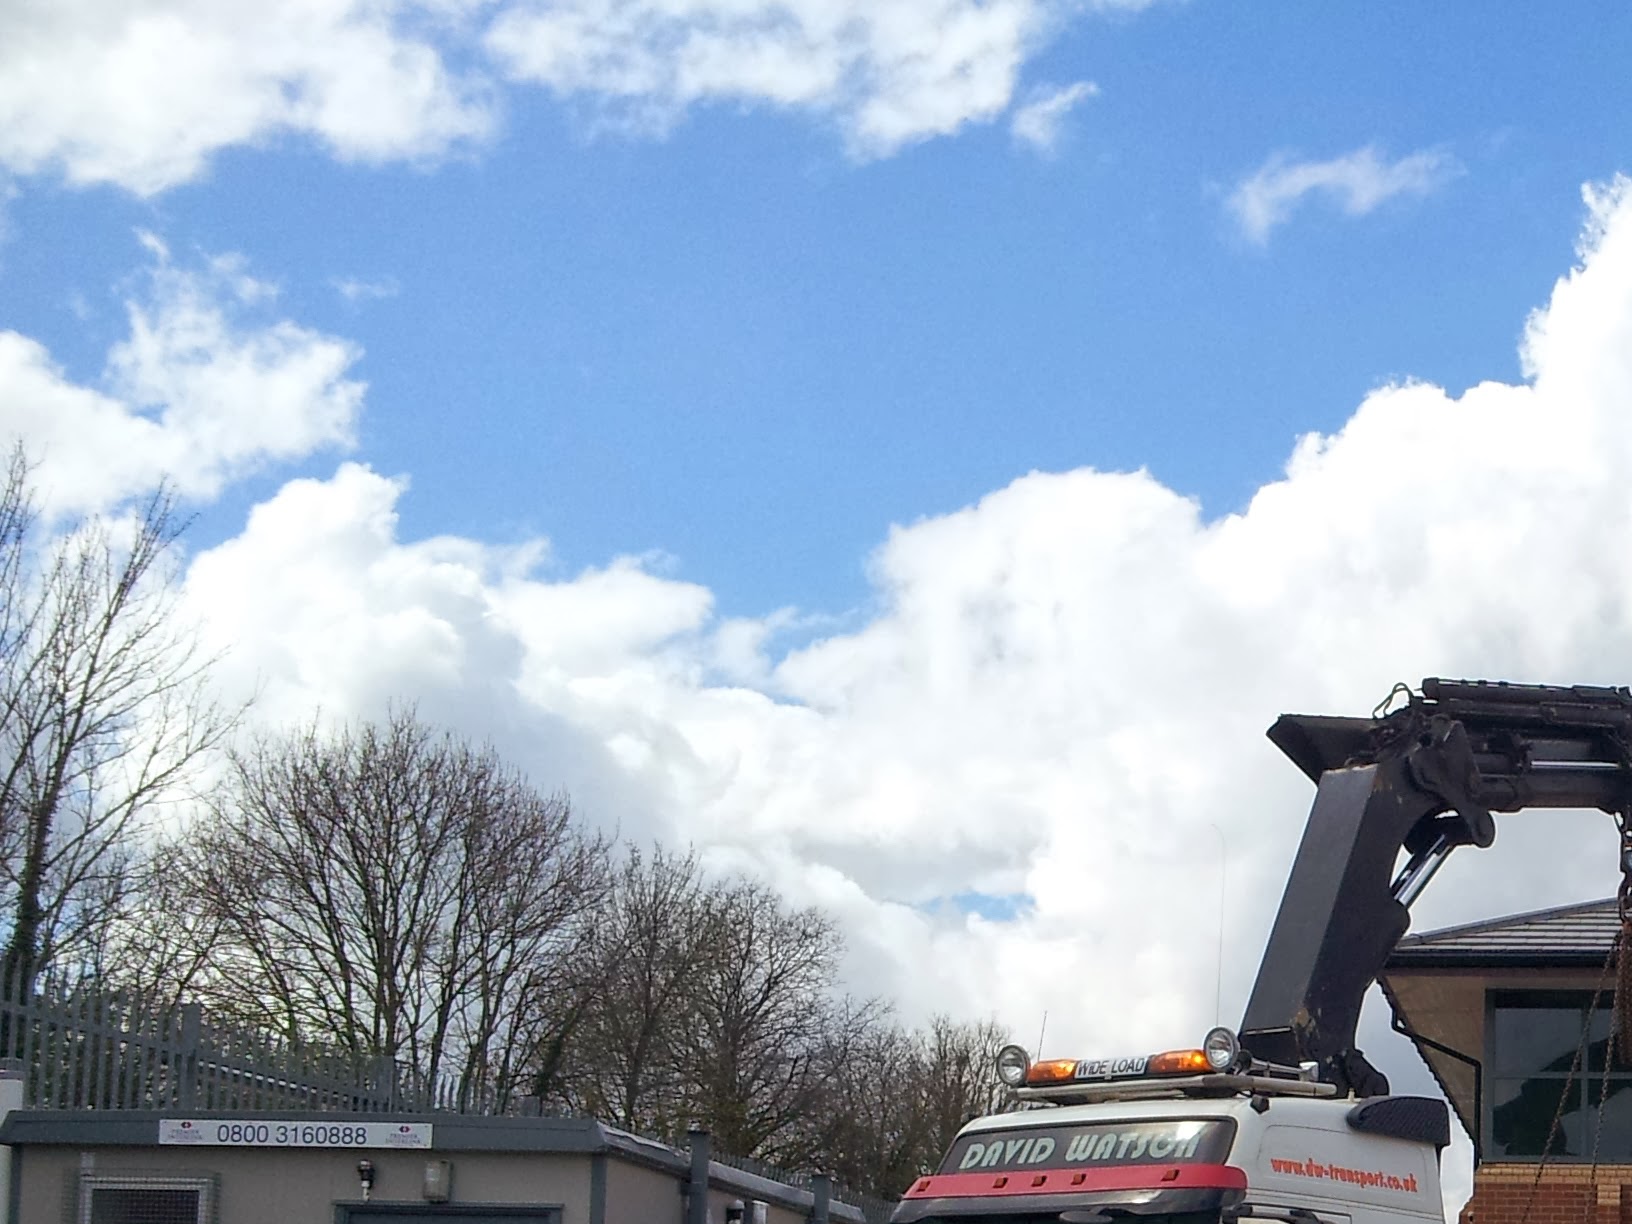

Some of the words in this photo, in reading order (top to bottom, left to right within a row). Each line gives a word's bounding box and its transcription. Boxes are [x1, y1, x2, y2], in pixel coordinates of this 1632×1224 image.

[1078, 1059, 1106, 1077] WIDE
[1111, 1057, 1146, 1074] LOAD
[217, 1125, 268, 1143] 0800
[275, 1126, 367, 1145] 3160888
[959, 1136, 1057, 1170] DAVID
[1065, 1129, 1205, 1162] WATSON
[1271, 1158, 1418, 1192] www.dw-transport.co.uk
